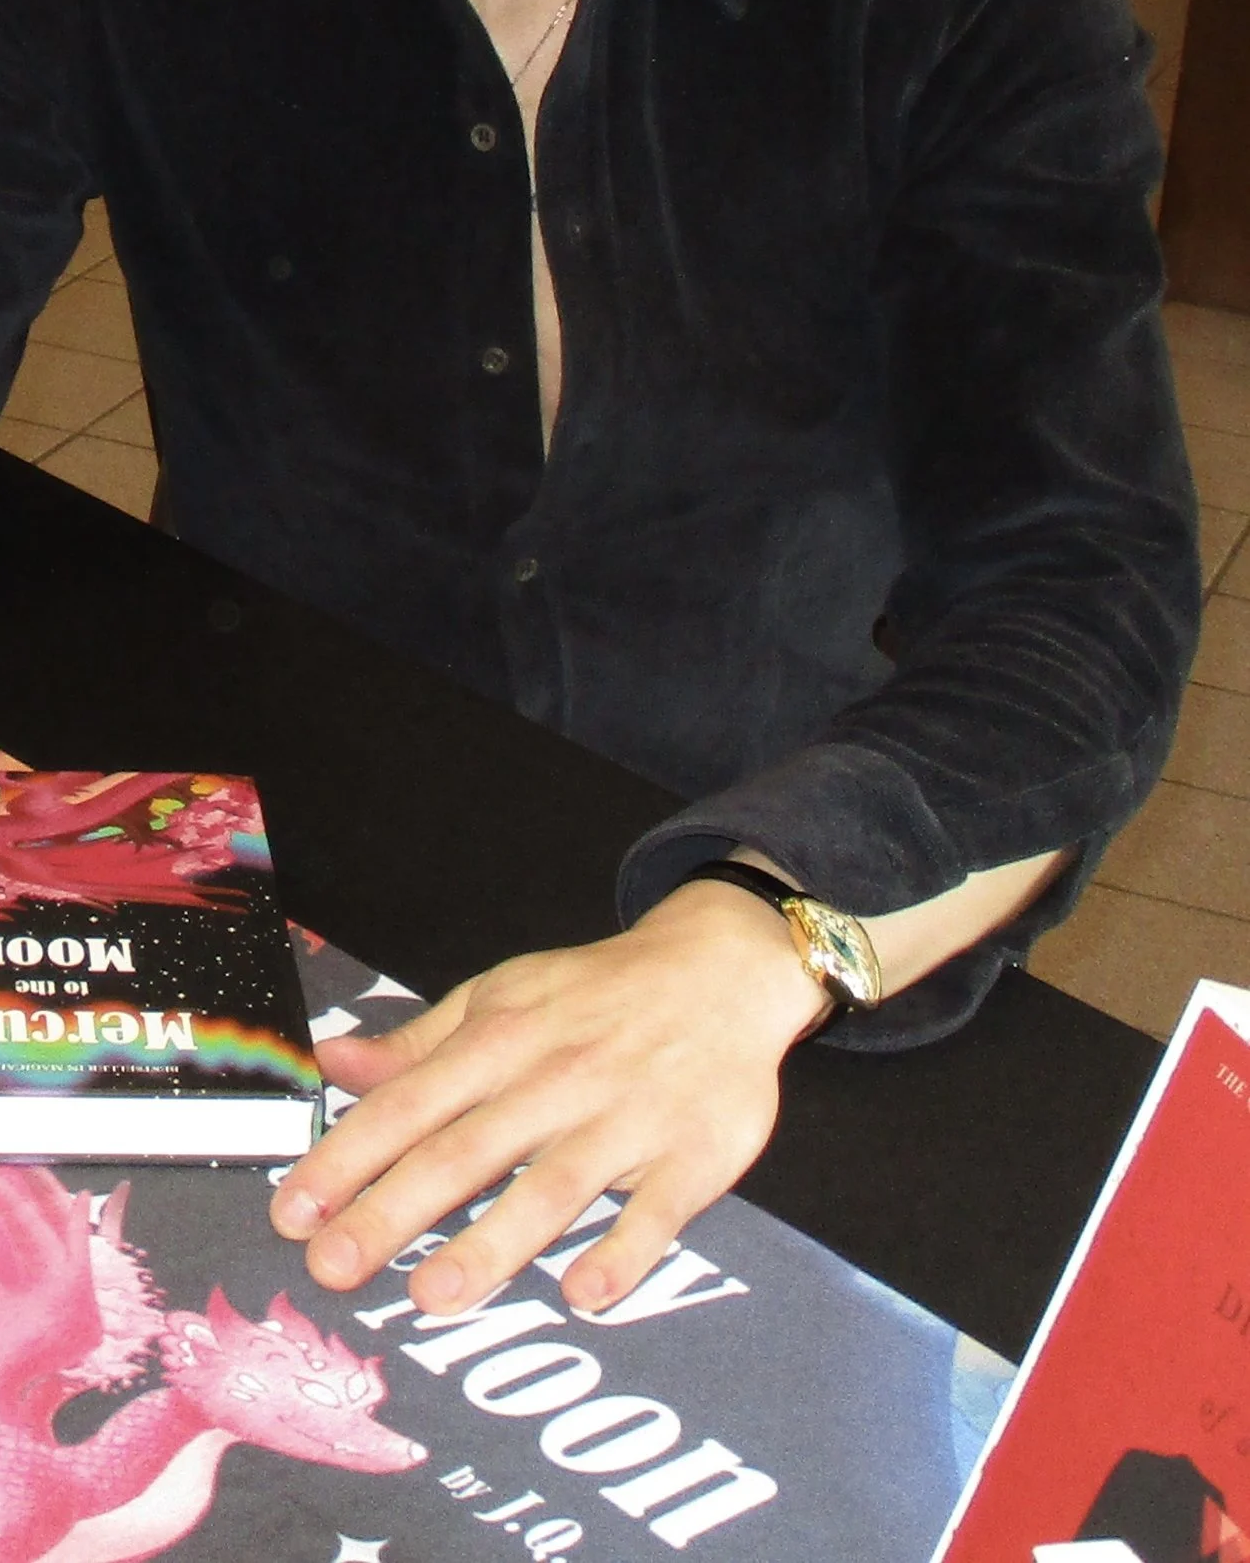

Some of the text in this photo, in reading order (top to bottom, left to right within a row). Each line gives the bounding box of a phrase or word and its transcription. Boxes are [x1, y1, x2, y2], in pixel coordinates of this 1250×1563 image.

[15, 979, 89, 996] to the
[1216, 1063, 1247, 1097] THE
[354, 1280, 779, 1550] Moon
[438, 1465, 492, 1499] by
